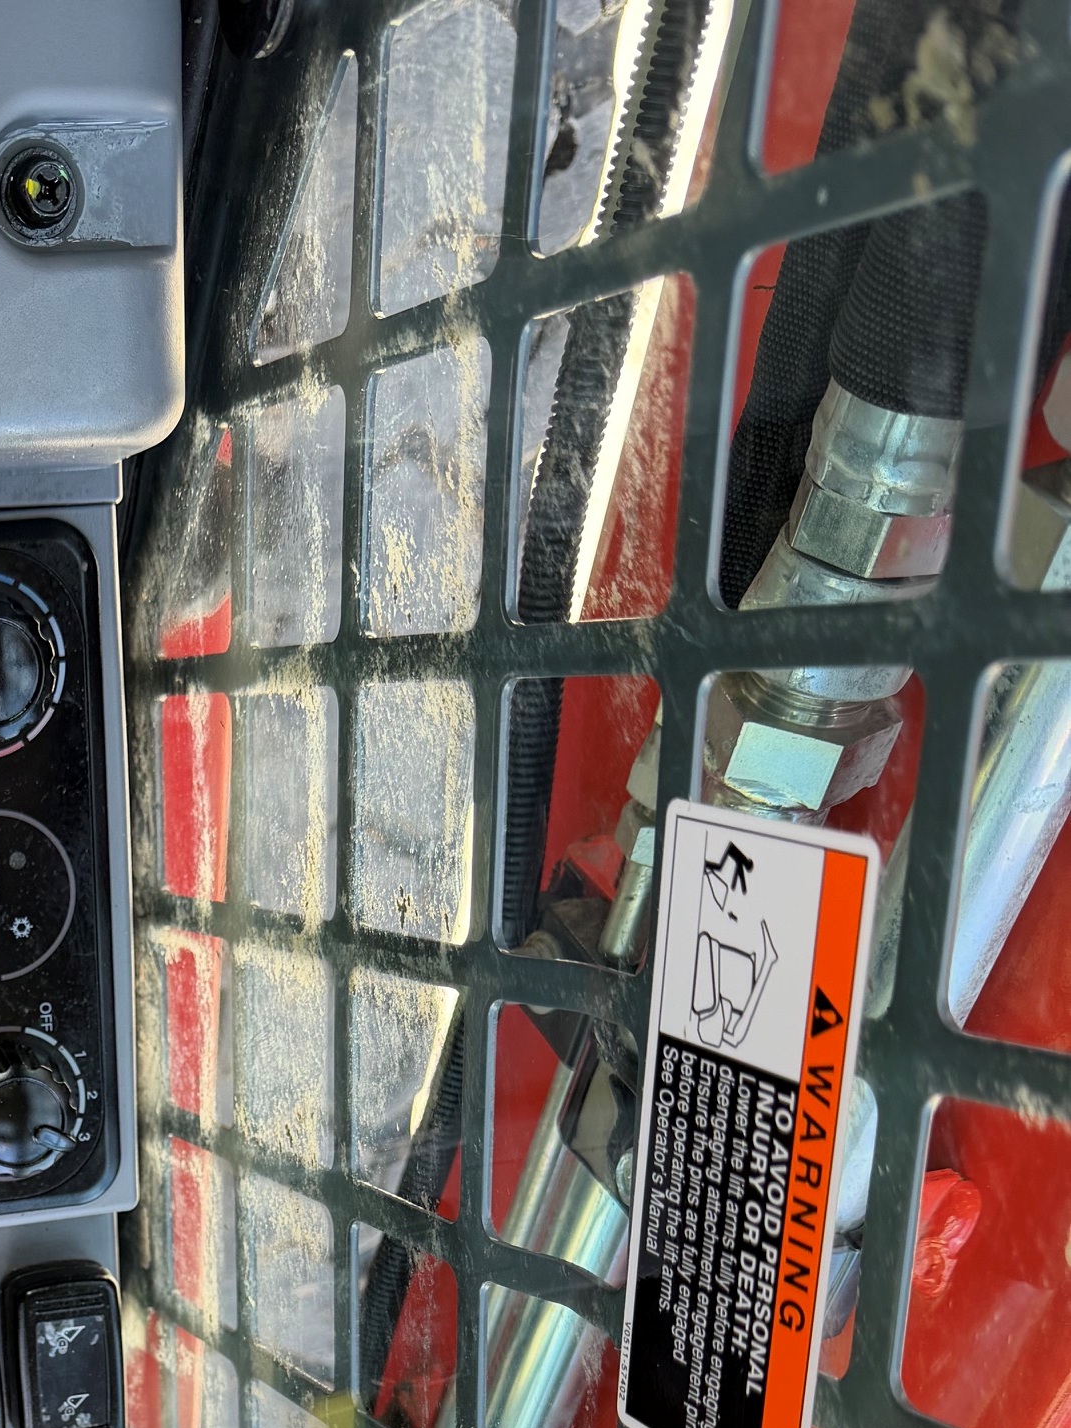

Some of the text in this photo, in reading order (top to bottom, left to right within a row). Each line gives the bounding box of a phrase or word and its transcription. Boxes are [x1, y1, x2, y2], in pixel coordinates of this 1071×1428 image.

[39, 1002, 53, 1032] OFF
[86, 1091, 99, 1100] 2
[706, 1064, 731, 1184] disengaging
[734, 1072, 756, 1139] Lower
[78, 1132, 91, 1142] 3
[646, 1044, 678, 1257] See Operator's Manual
[731, 1142, 747, 1171] the
[659, 1051, 697, 1312] before operating the lift arms.
[672, 1059, 716, 1365] Ensure the pins are fully engaged
[730, 1173, 745, 1200] lift
[731, 1081, 775, 1356] INJURY OR DEATH:
[779, 1066, 834, 1332] WARNING
[700, 1187, 720, 1292] attachment
[722, 1203, 738, 1250] arms
[746, 1091, 795, 1396] TO AVOID PERSONAL
[716, 1252, 737, 1291] fully
[619, 1322, 631, 1401] V0511-57402
[688, 1293, 709, 1405] engagement
[713, 1292, 732, 1352] before
